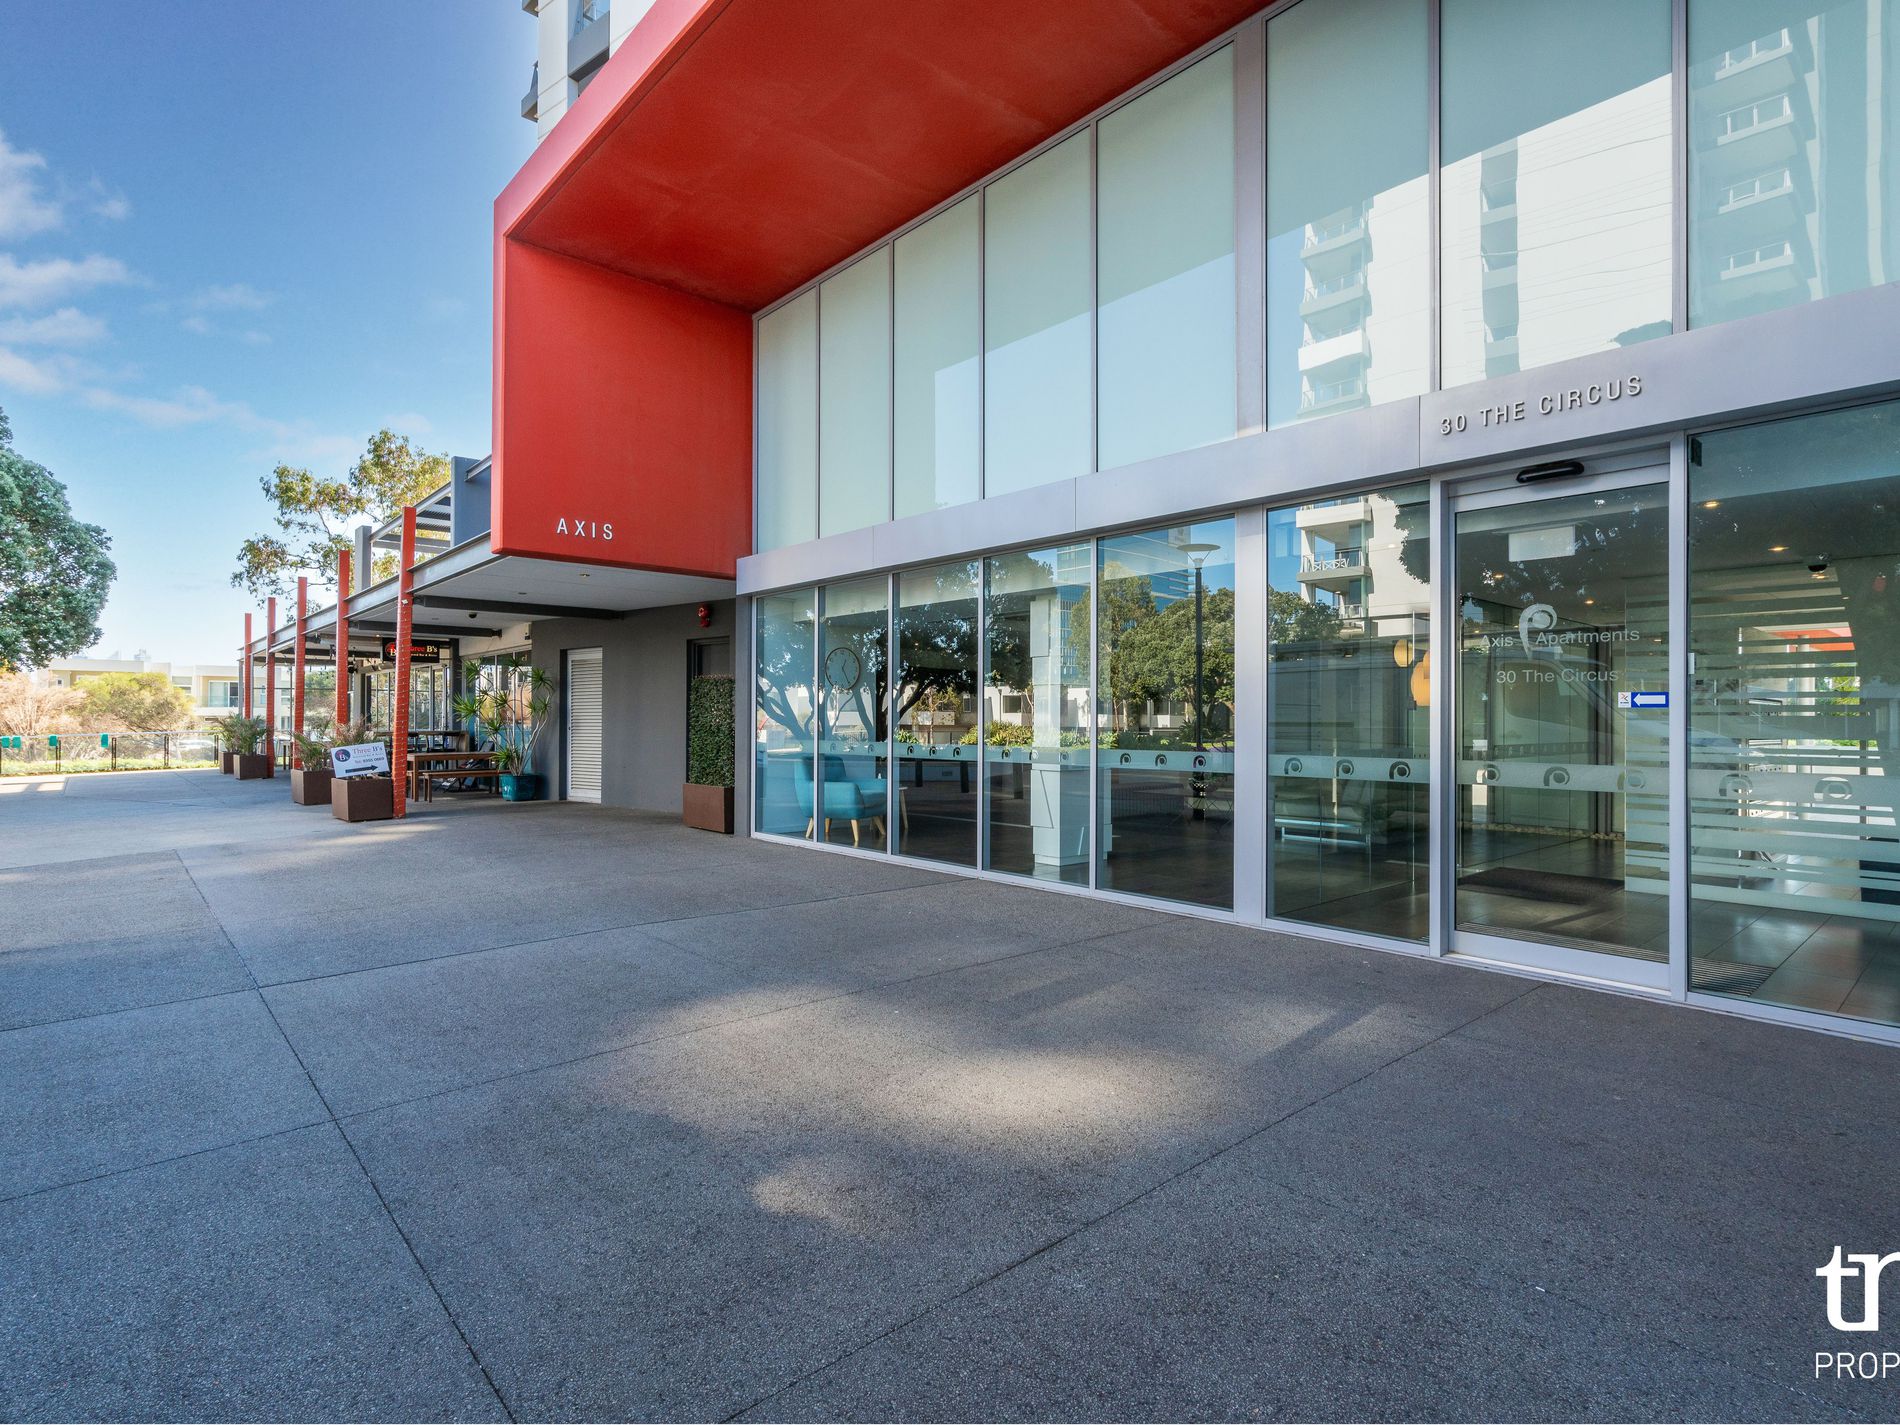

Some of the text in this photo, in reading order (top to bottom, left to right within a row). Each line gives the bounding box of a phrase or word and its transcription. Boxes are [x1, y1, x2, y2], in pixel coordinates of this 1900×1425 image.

[1440, 375, 1642, 435] 30 THE CIRCUS
[556, 517, 613, 540] AXIS
[1480, 628, 1640, 648] Axis Apartments
[1496, 668, 1619, 684] 30 The Circus
